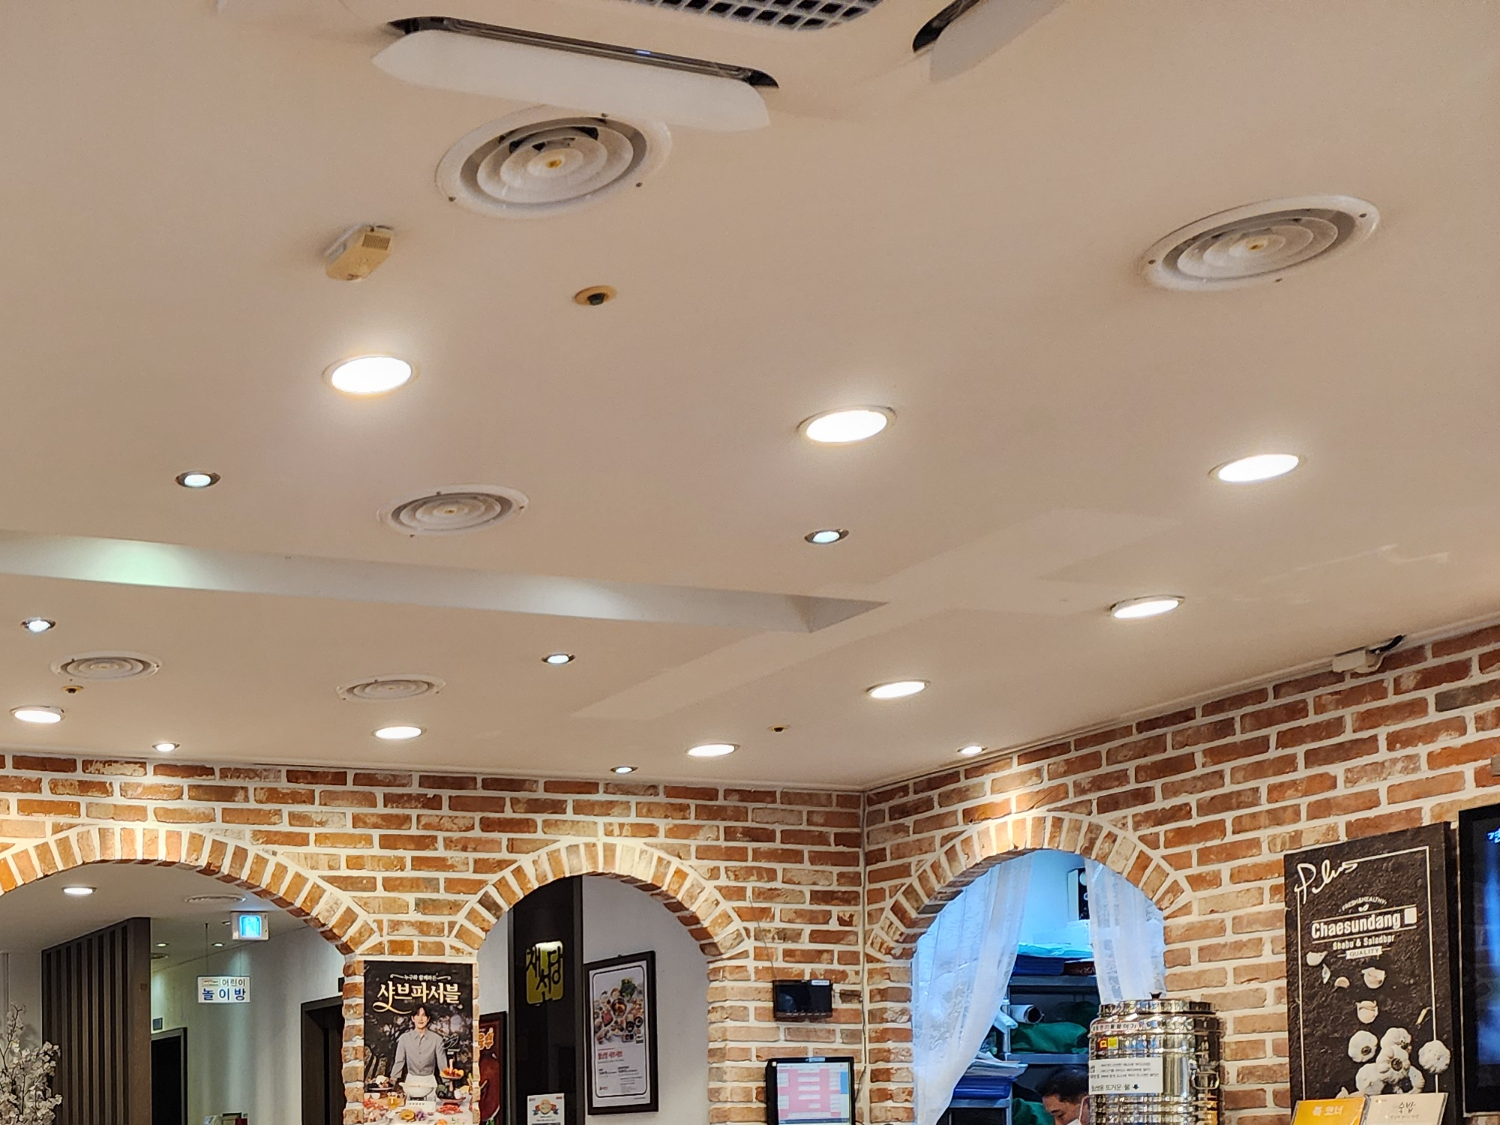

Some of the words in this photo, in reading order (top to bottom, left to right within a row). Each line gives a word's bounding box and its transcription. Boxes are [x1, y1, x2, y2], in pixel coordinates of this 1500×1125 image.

[1311, 913, 1401, 939] Chaesundang
[1332, 940, 1354, 950] Shabu
[1355, 939, 1361, 947] &
[1349, 948, 1379, 957] QUALITY
[221, 979, 246, 987] 어린이
[373, 980, 461, 1014] 샤브파서블
